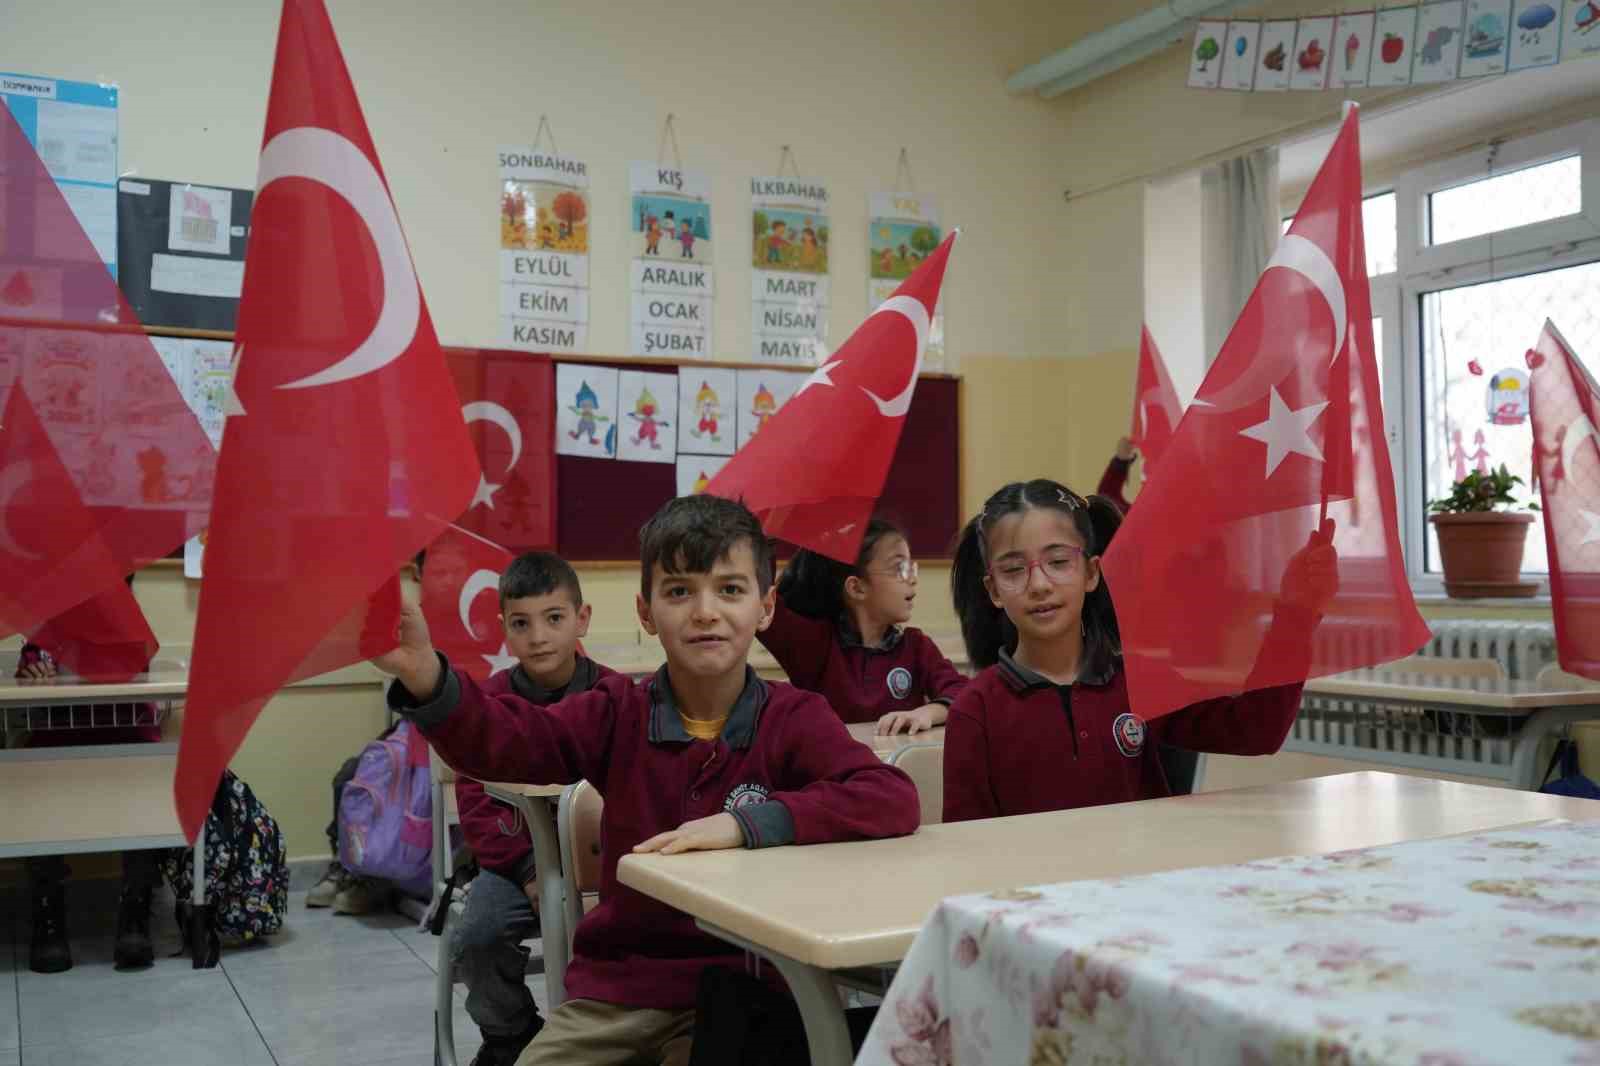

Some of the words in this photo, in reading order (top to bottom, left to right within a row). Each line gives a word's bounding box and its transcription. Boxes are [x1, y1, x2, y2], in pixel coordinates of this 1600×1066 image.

[500, 154, 586, 175] SONBAHAR
[657, 169, 684, 190] KIŞ
[751, 177, 828, 201] İLKBAHAR
[514, 255, 572, 277] EYLÜL
[641, 267, 705, 287] ARALIK
[766, 278, 816, 297] MART
[519, 292, 568, 313] EKİM
[648, 301, 699, 319] OCAK
[763, 308, 817, 329] NİSAN
[513, 325, 575, 347] KASIM
[644, 332, 704, 352] ŞUBAT
